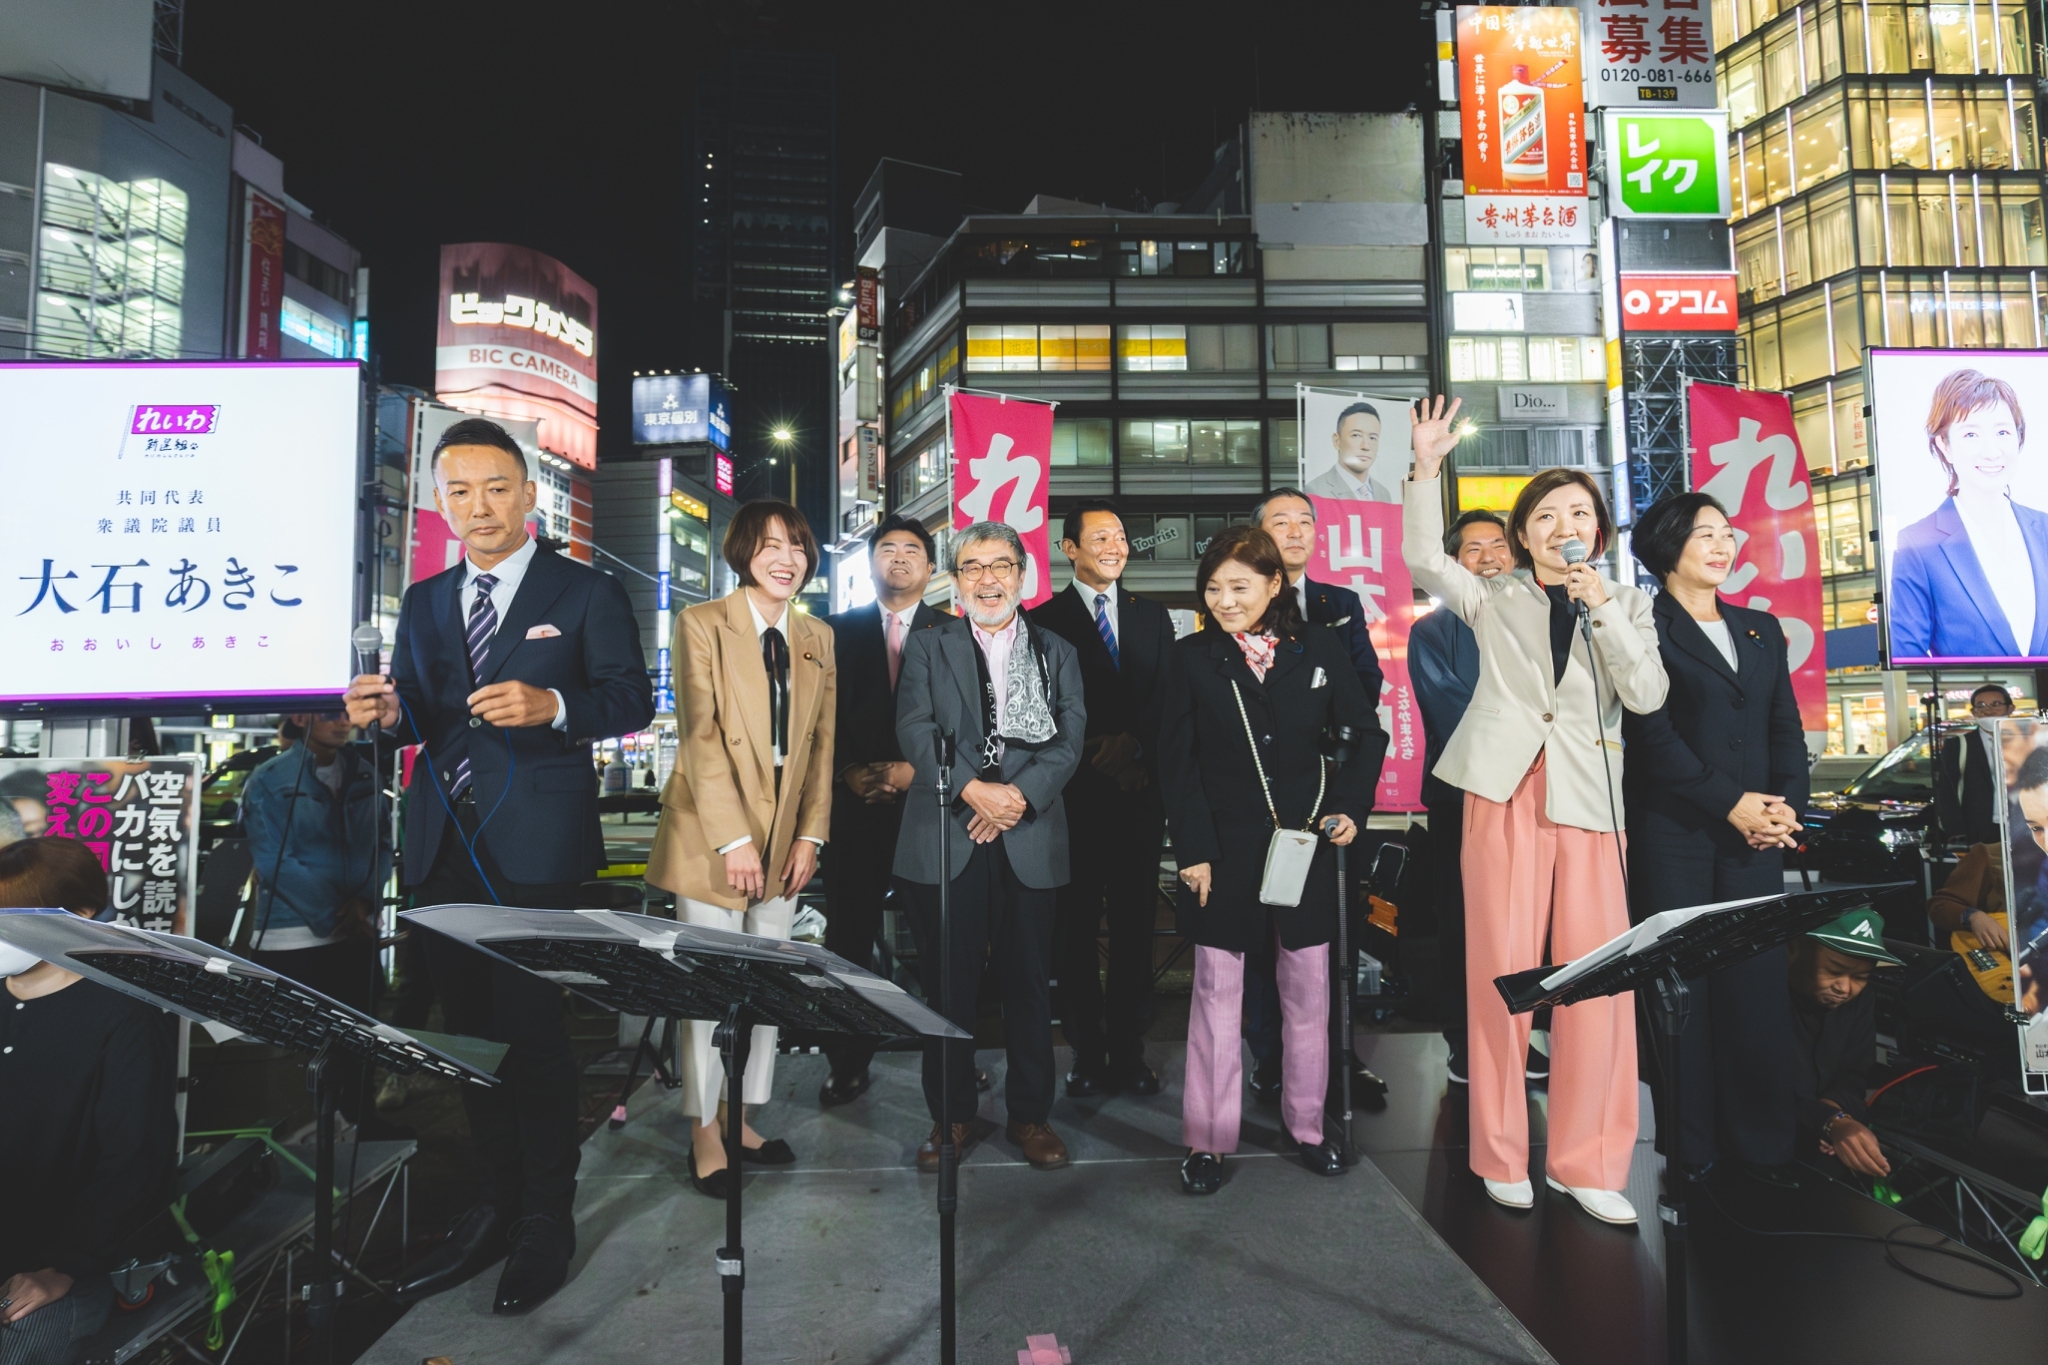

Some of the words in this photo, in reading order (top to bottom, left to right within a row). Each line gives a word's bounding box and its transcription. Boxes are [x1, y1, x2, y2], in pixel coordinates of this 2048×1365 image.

[1600, 14, 1711, 64] 募集
[1601, 68, 1712, 83] 0120-081-666
[1640, 88, 1676, 98] TB-139
[1655, 290, 1729, 315] アコム
[450, 292, 594, 358] ビックカメラ
[860, 327, 876, 338] 6F
[469, 348, 503, 364] BIC
[509, 352, 579, 389] CAMERA
[1514, 392, 1556, 408] Dio...
[136, 407, 207, 432] れいわ
[644, 410, 698, 426] 東京個別
[116, 490, 204, 506] 共同代表
[96, 517, 221, 534] 衆議院議員
[1133, 528, 1178, 550] Tourist
[14, 557, 303, 618] 大石あきこ
[50, 636, 162, 652] おおいし
[192, 635, 270, 650] あきこ
